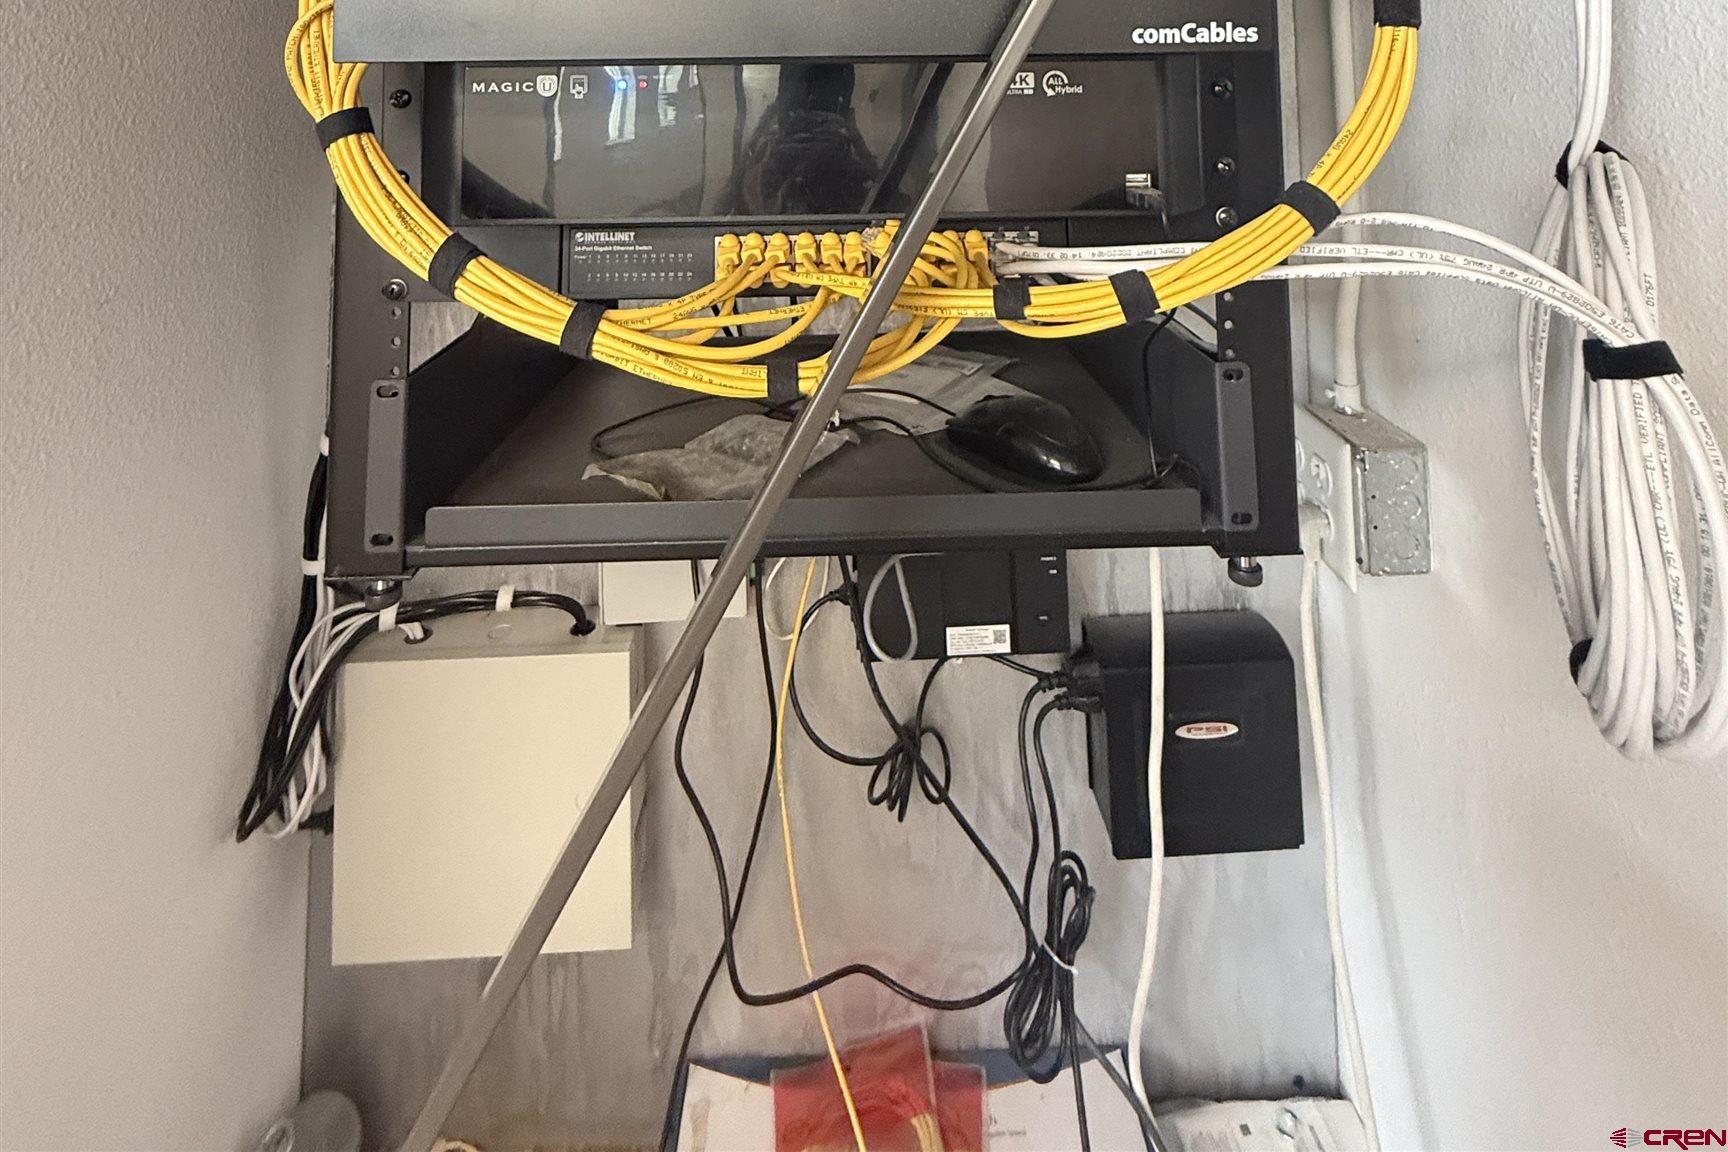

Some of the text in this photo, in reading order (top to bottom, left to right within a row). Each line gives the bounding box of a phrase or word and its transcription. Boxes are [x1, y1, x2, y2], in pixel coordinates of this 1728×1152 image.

[1131, 22, 1259, 44] comCables
[1048, 77, 1063, 85] ALL
[472, 81, 534, 93] MAGIC
[1055, 85, 1083, 95] Hybrid
[584, 231, 635, 242] INTELLINET
[1301, 246, 1346, 255] VERIFIED
[1523, 277, 1543, 288] UTP
[1609, 319, 1635, 339] CAT6
[1681, 390, 1699, 416] Data
[1631, 392, 1649, 444] VERIFIED
